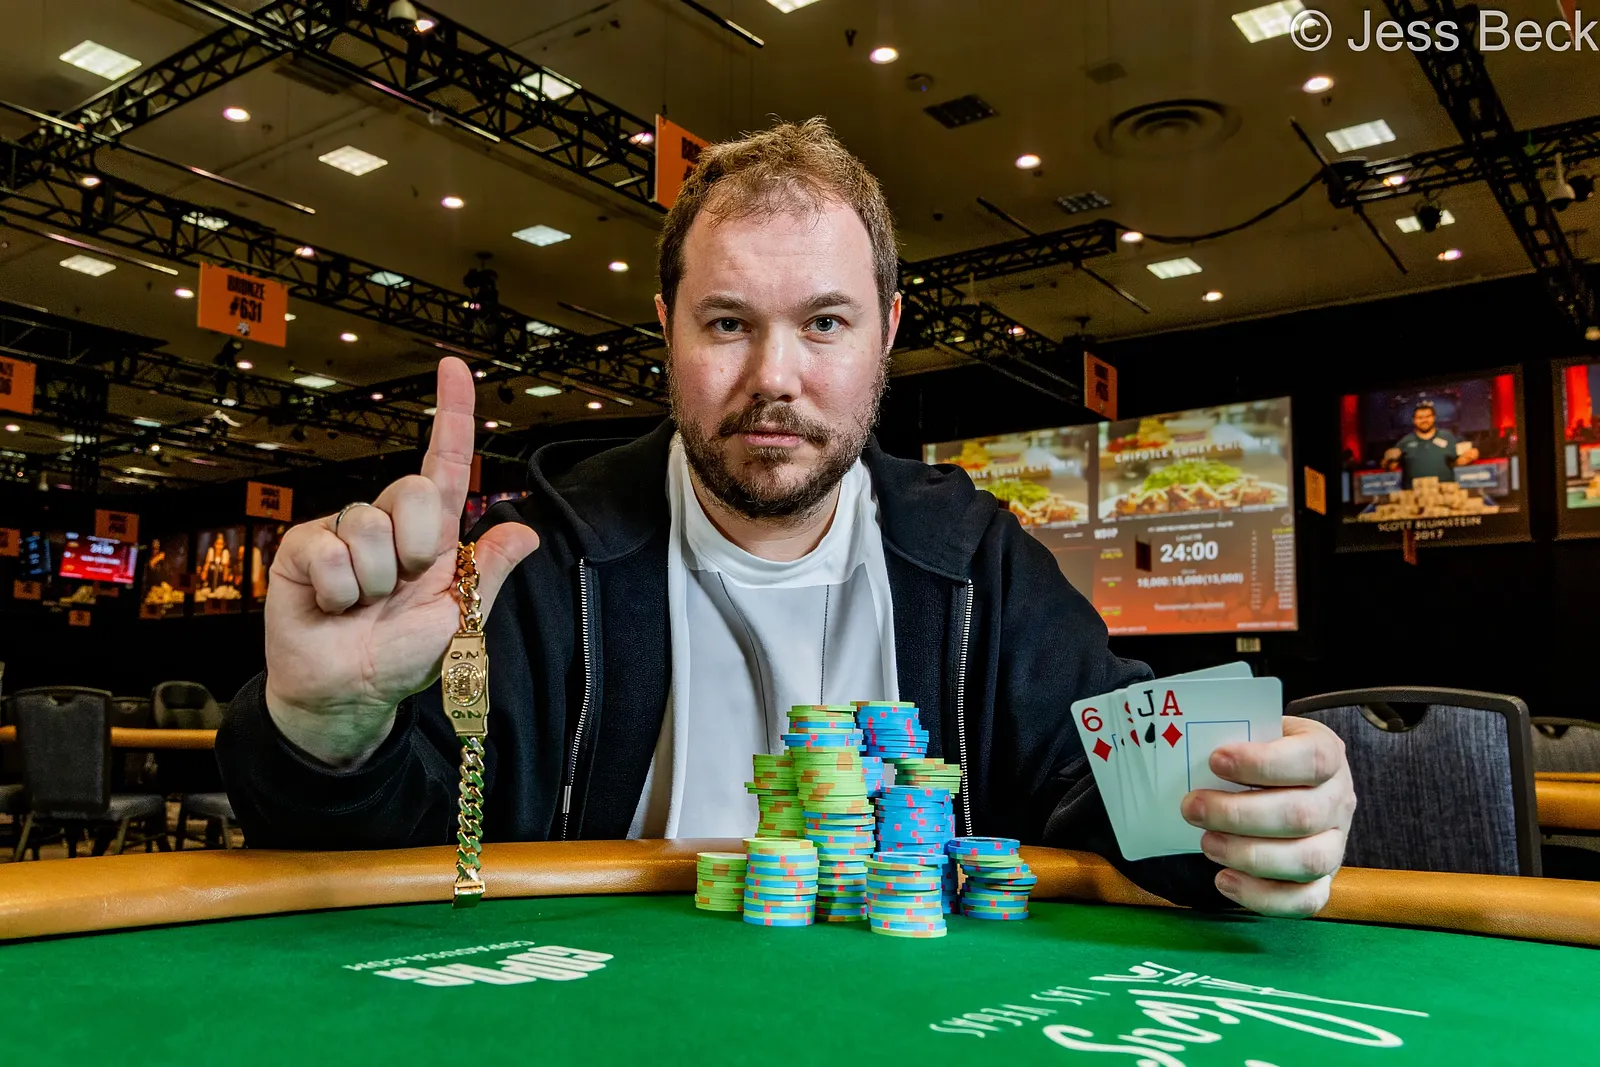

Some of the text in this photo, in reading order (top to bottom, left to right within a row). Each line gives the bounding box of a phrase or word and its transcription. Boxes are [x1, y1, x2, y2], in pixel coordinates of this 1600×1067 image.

[227, 275, 265, 301] BRONZE
[229, 296, 262, 323] #631
[1160, 541, 1219, 563] 24:00
[1137, 689, 1154, 717] J
[1159, 690, 1183, 716] A
[1081, 707, 1103, 732] 6
[373, 945, 614, 987] COPAG
[929, 986, 1111, 1038] LAS VEGAS
